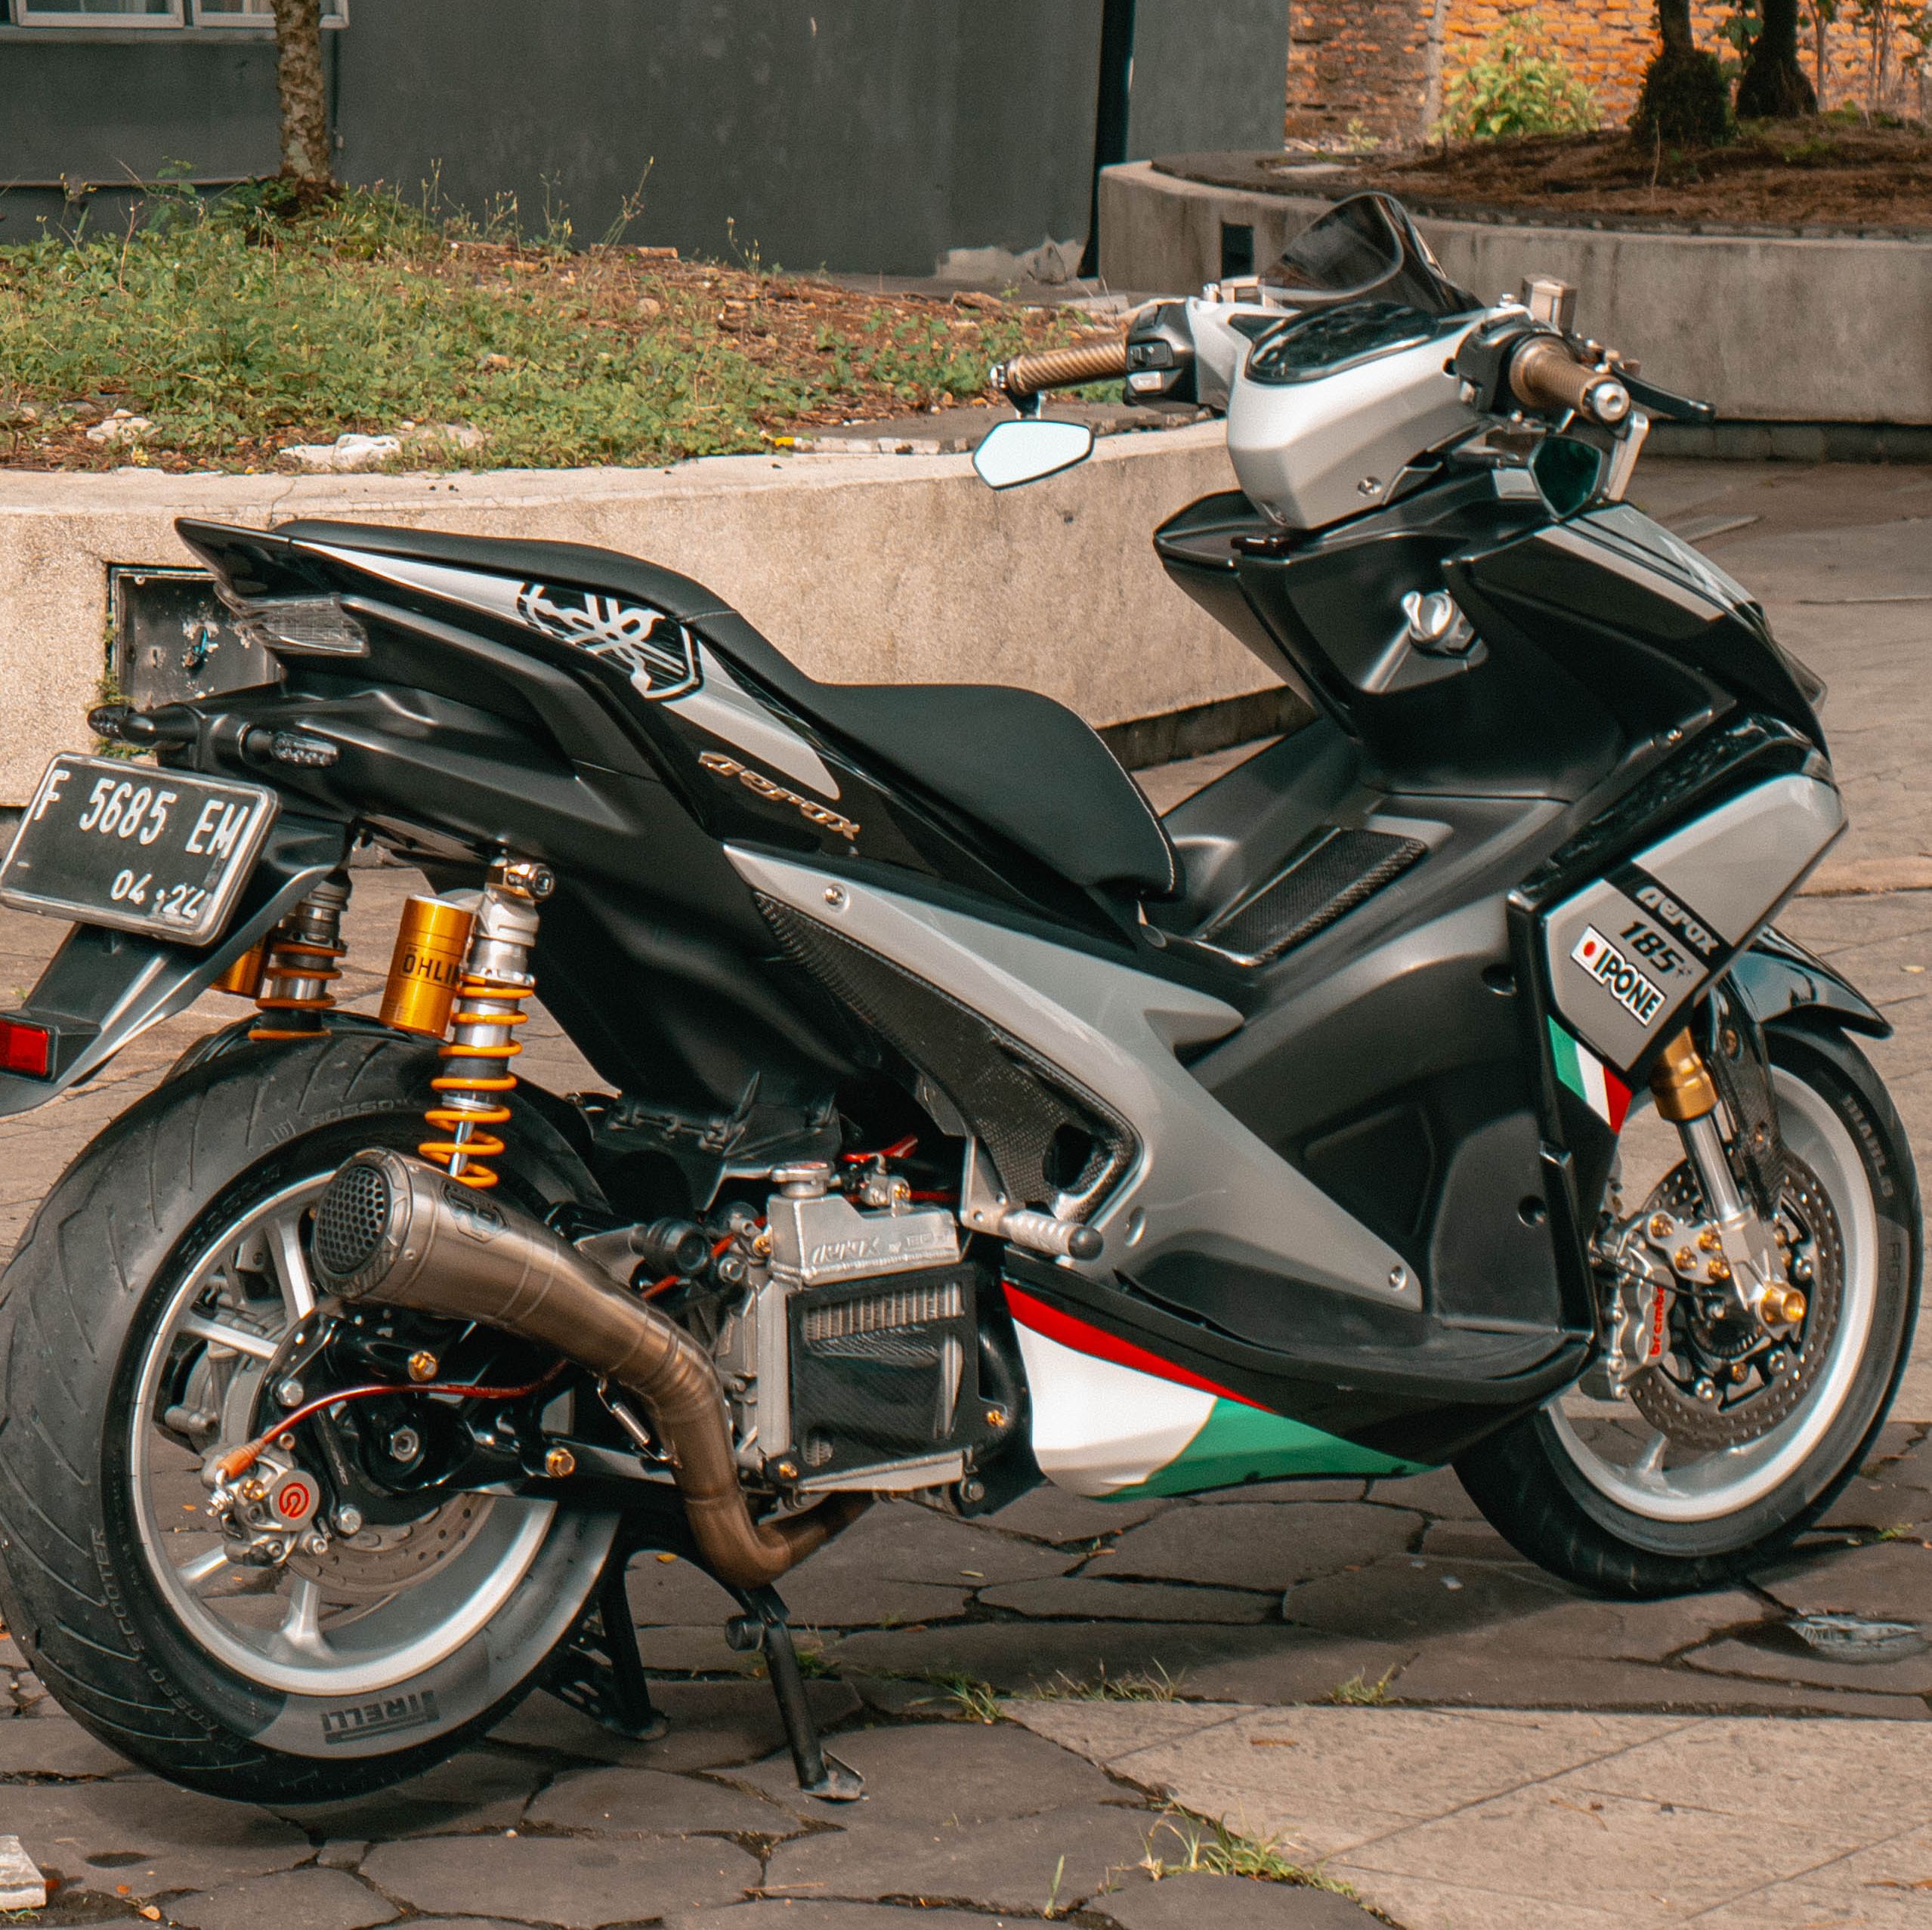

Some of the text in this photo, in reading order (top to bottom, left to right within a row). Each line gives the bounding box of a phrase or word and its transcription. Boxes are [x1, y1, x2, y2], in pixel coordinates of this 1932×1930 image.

[33, 770, 249, 860] F 5685 EM
[1593, 946, 1662, 1021] IPONE
[320, 1691, 440, 1745] PIRELLI
